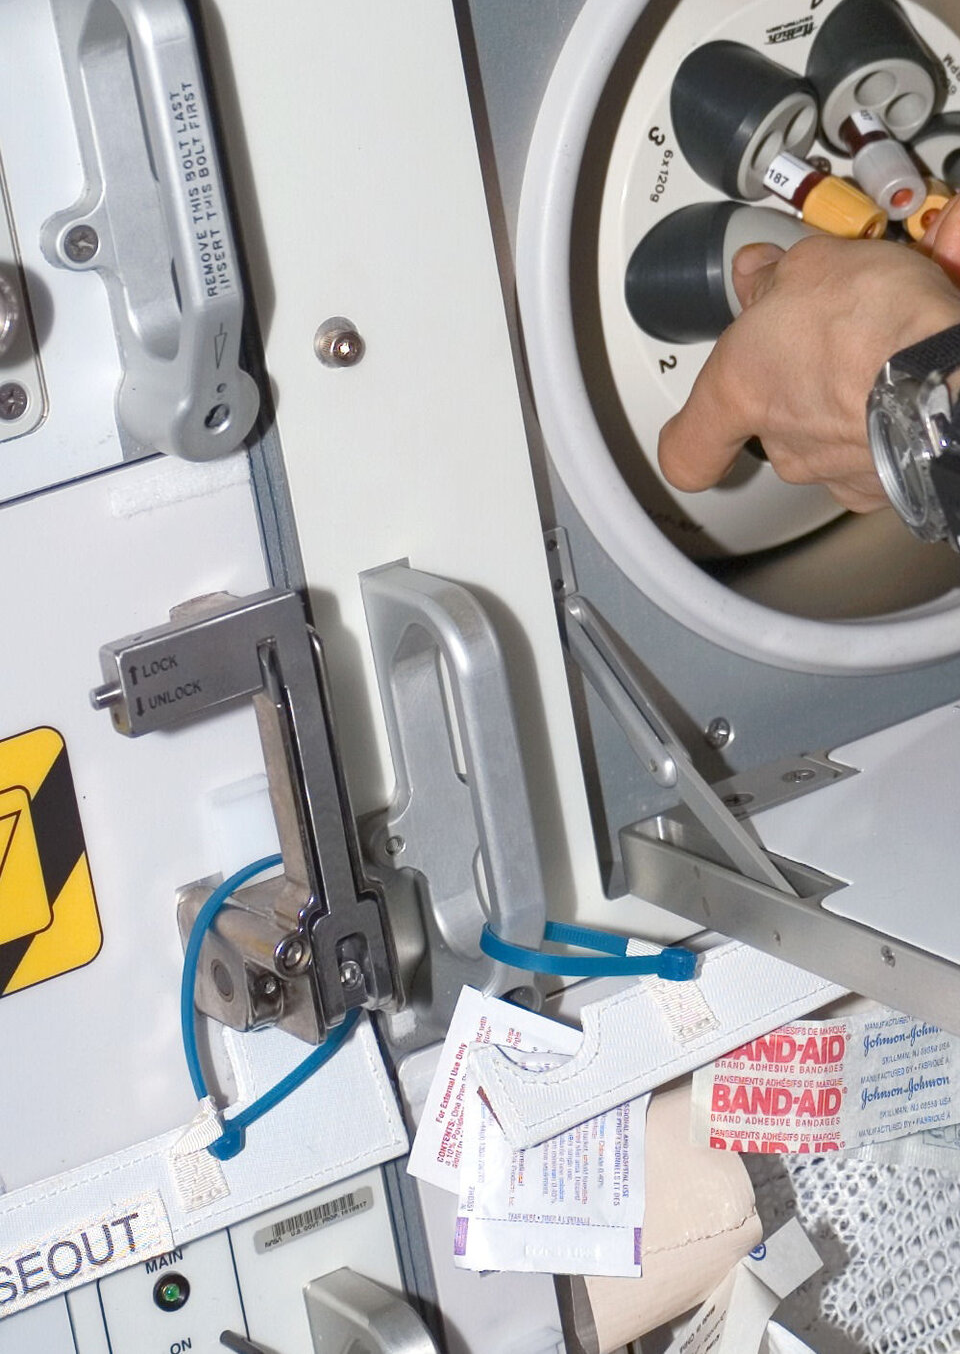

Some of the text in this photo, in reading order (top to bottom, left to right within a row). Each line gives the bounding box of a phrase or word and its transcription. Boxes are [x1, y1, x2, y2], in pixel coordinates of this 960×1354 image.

[648, 126, 666, 146] 3
[169, 92, 218, 297] REMOVE THIS BOLT LAST
[181, 82, 231, 290] INSERT THIS BOLT FIRST
[658, 355, 677, 374] 2
[142, 654, 178, 678] LOCK
[149, 680, 203, 710] UNLOCK
[456, 1042, 468, 1060] Only
[451, 1061, 461, 1077] Use
[715, 1059, 843, 1074] BRAND ADHESIVE BANDAGES
[714, 1074, 763, 1086] PANSEMENTS
[440, 1076, 457, 1109] External
[711, 1083, 842, 1117] BAND-AID
[436, 1109, 445, 1123] For
[710, 1113, 840, 1126] BRAND ADHESIVE BANDAGES
[710, 1127, 760, 1140] PANSEMENTS
[145, 1248, 183, 1275] MAIN
[170, 1337, 192, 1354] ON
